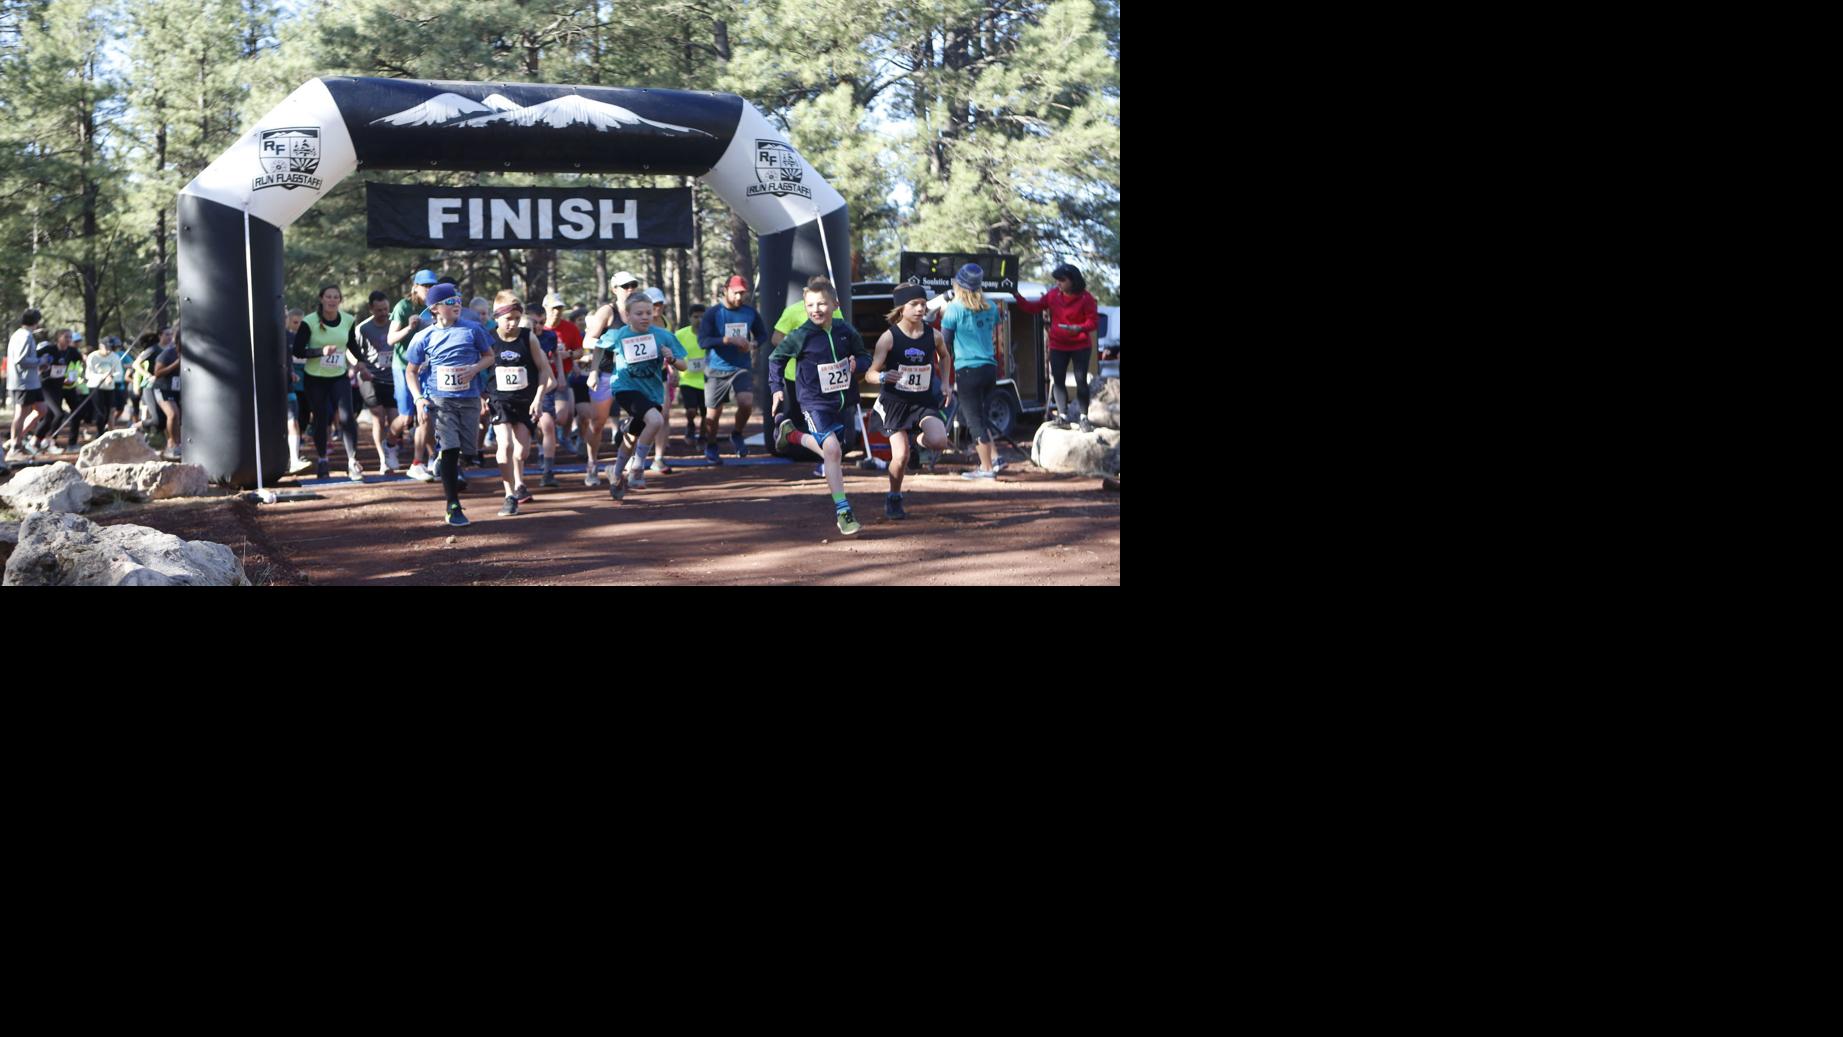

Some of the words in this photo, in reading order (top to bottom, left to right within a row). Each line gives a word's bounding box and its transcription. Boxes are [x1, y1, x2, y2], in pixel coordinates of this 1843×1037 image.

[255, 175, 274, 187] RUN
[276, 173, 321, 187] FLAGSTAFF
[749, 183, 767, 194] RUN
[768, 182, 810, 196] FLAGSTAFF
[427, 197, 639, 240] FINISH
[633, 343, 647, 357] 22
[325, 354, 340, 364] 217
[505, 374, 518, 385] 82
[828, 368, 849, 386] 225
[908, 373, 921, 386] 81
